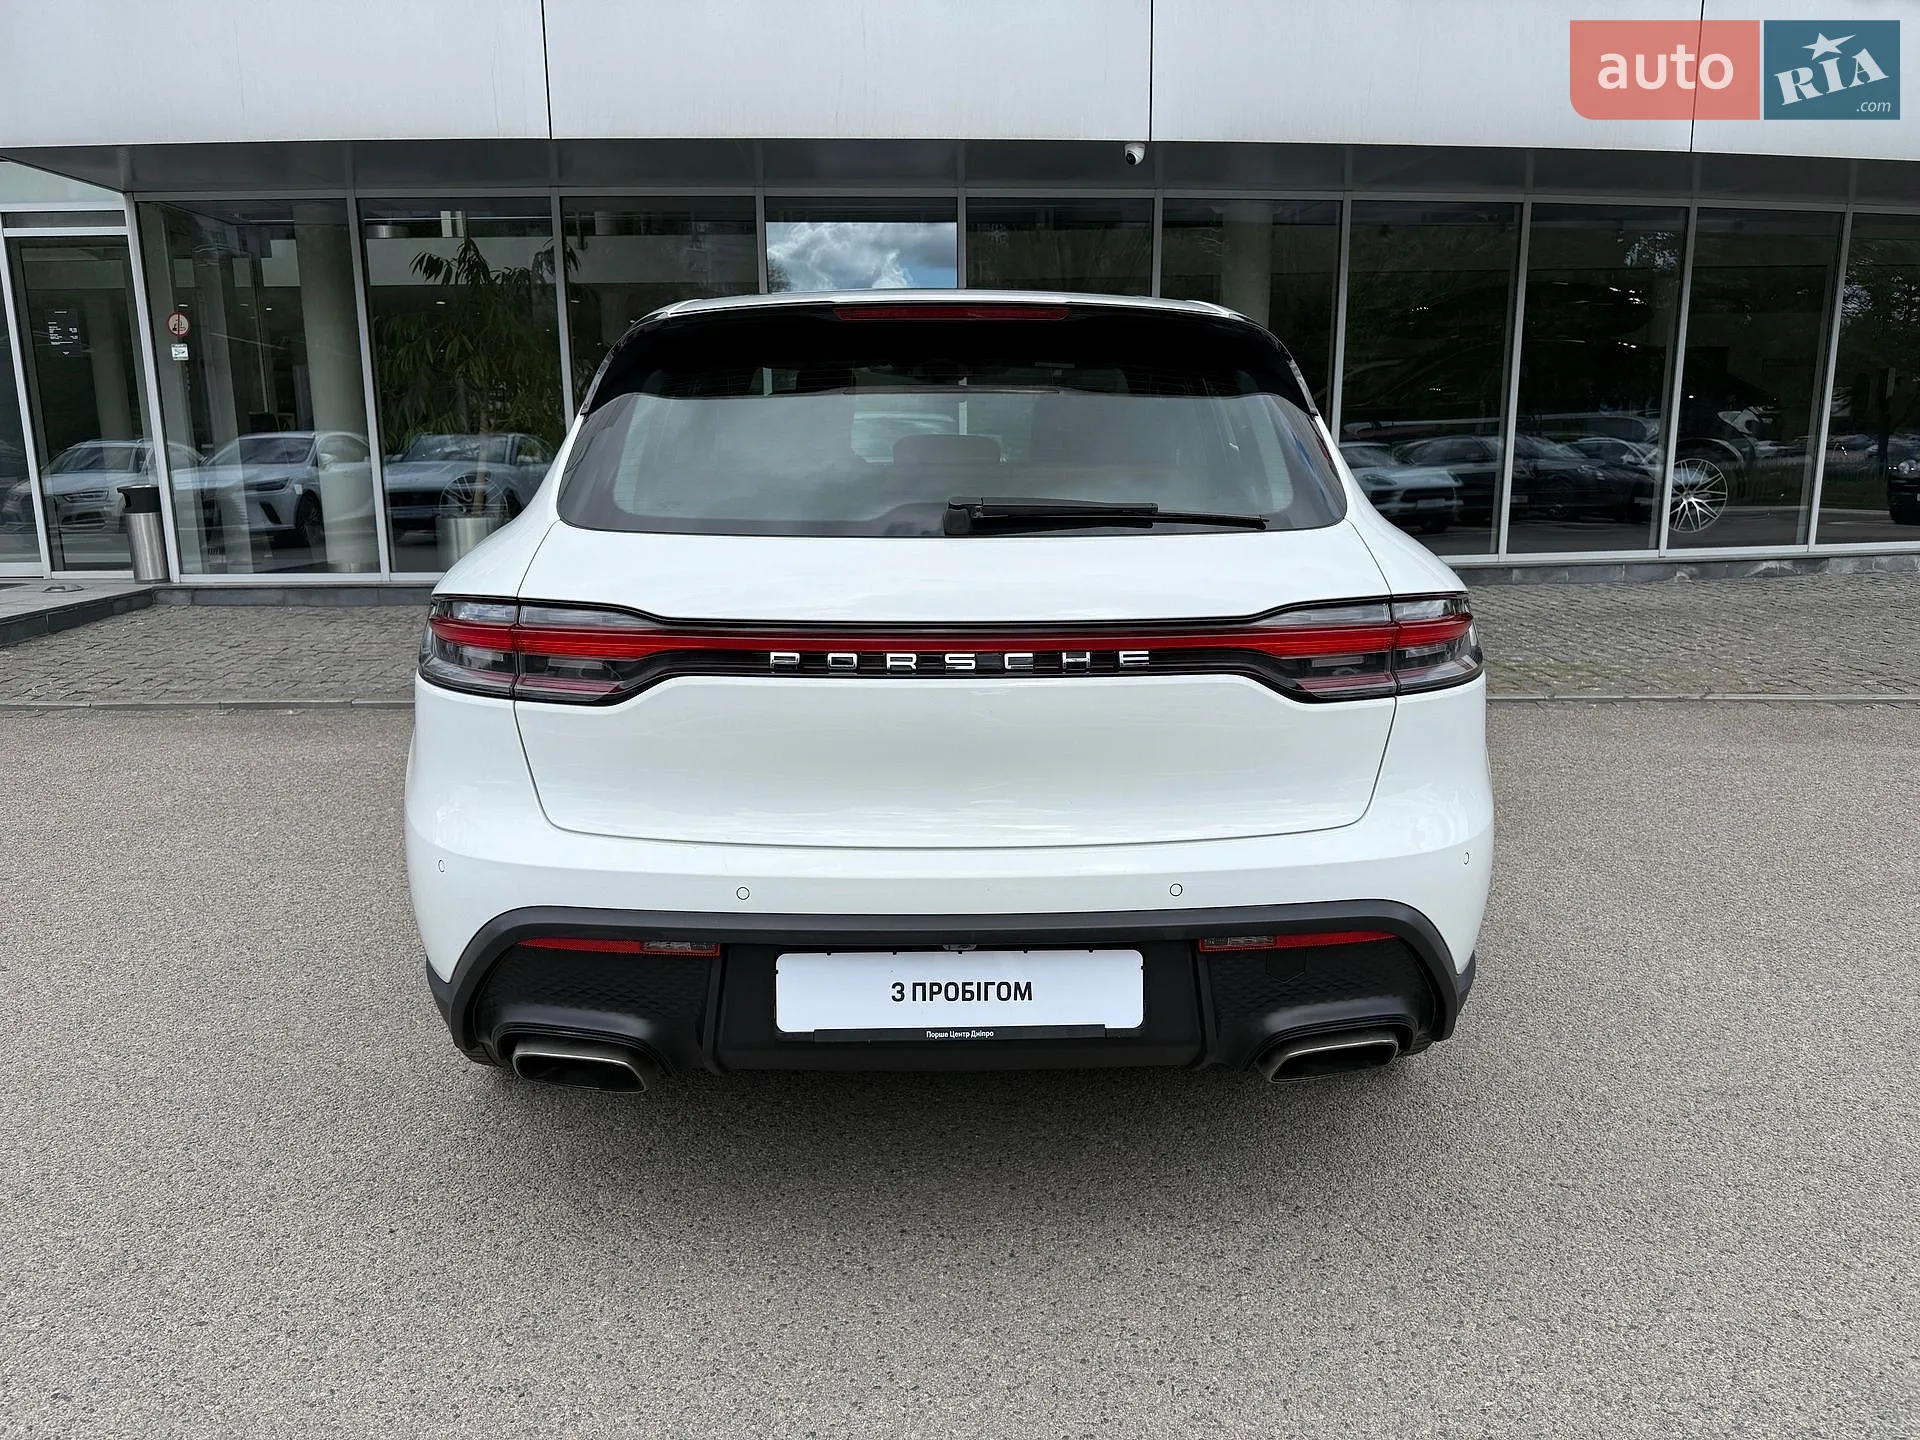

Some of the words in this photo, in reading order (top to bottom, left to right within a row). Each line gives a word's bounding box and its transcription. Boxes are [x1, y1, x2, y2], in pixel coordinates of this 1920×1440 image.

[769, 650, 1150, 671] PORSCHE
[911, 981, 1033, 1002] ПРОБІГОМ
[926, 1030, 949, 1040] Порше
[949, 1030, 970, 1039] Центр
[970, 1029, 994, 1039] Дніпро
